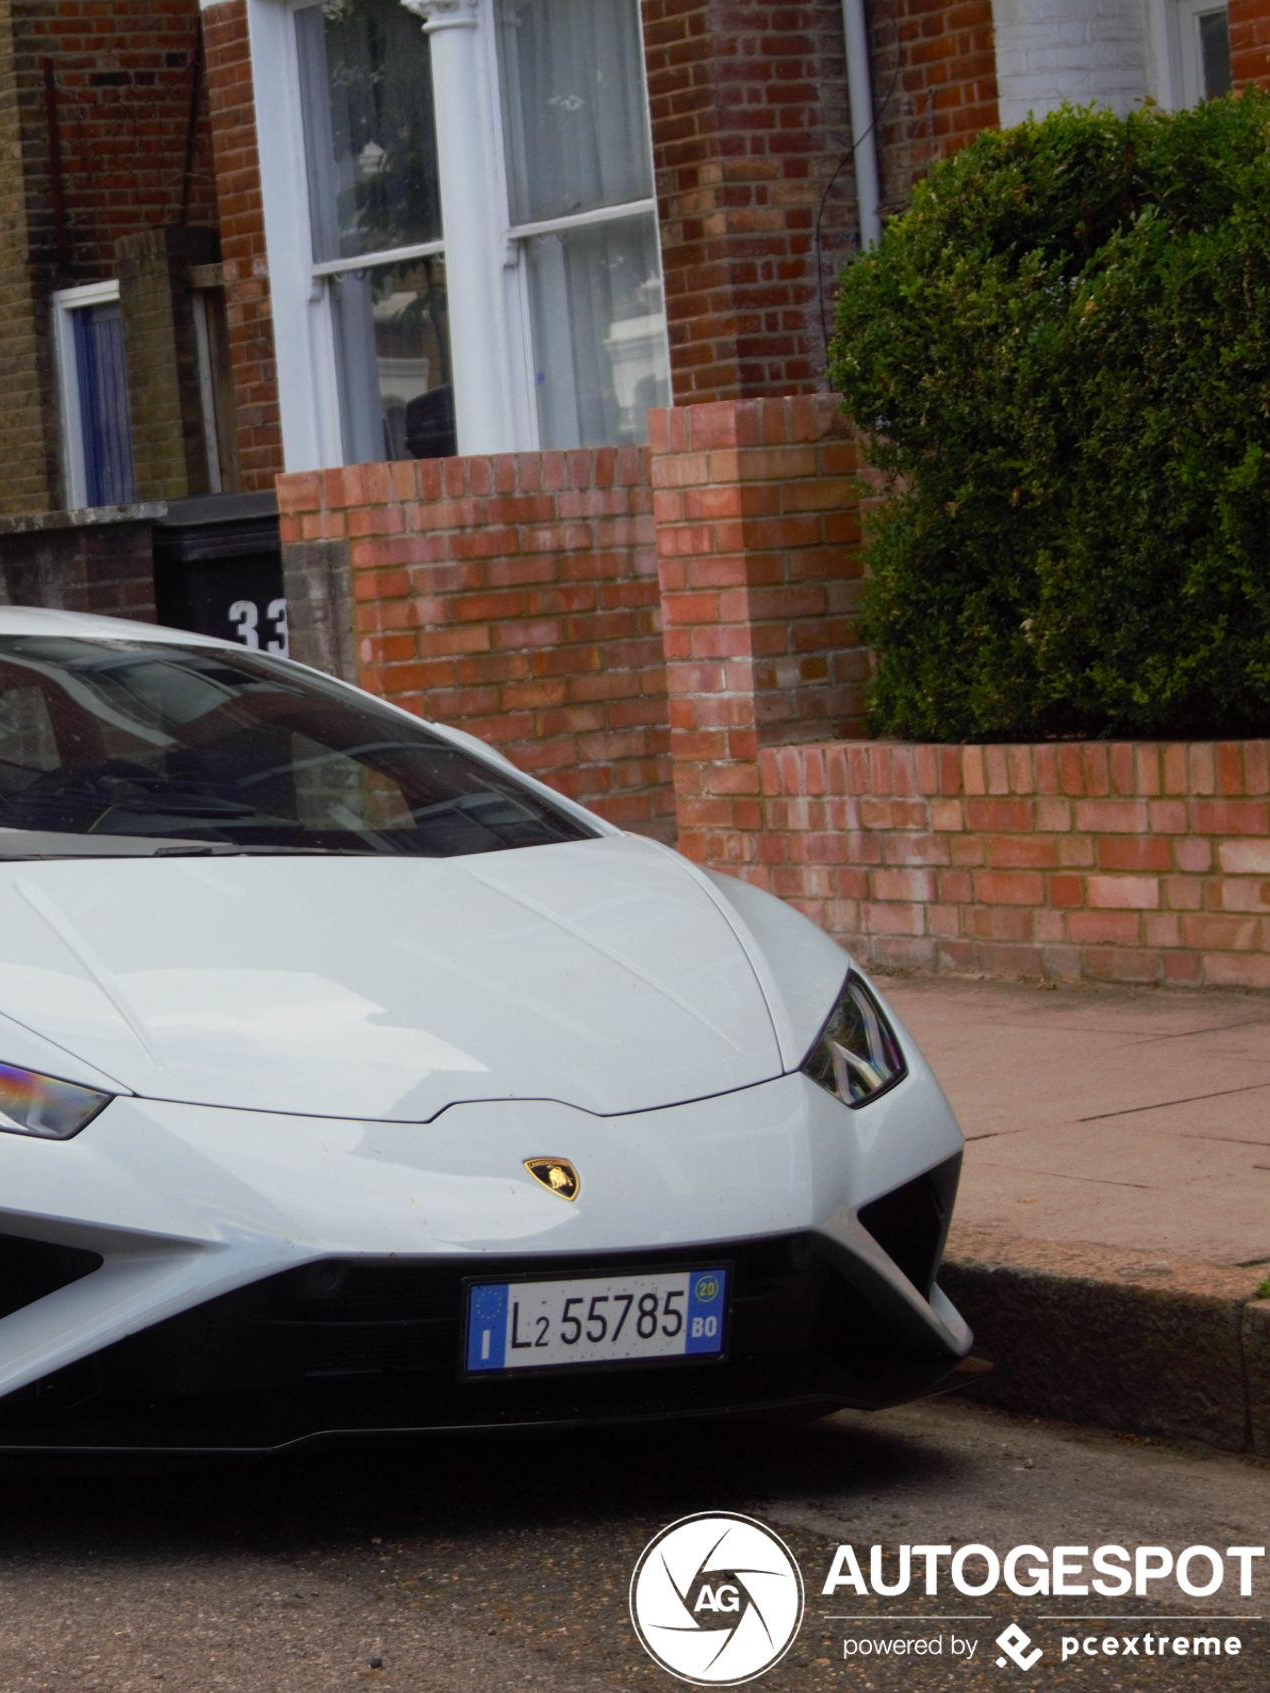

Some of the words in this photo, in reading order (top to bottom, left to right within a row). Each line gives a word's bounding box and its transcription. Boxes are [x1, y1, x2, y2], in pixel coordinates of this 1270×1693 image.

[699, 1282, 715, 1296] 20
[560, 1290, 685, 1345] 55785
[691, 1315, 717, 1338] BO
